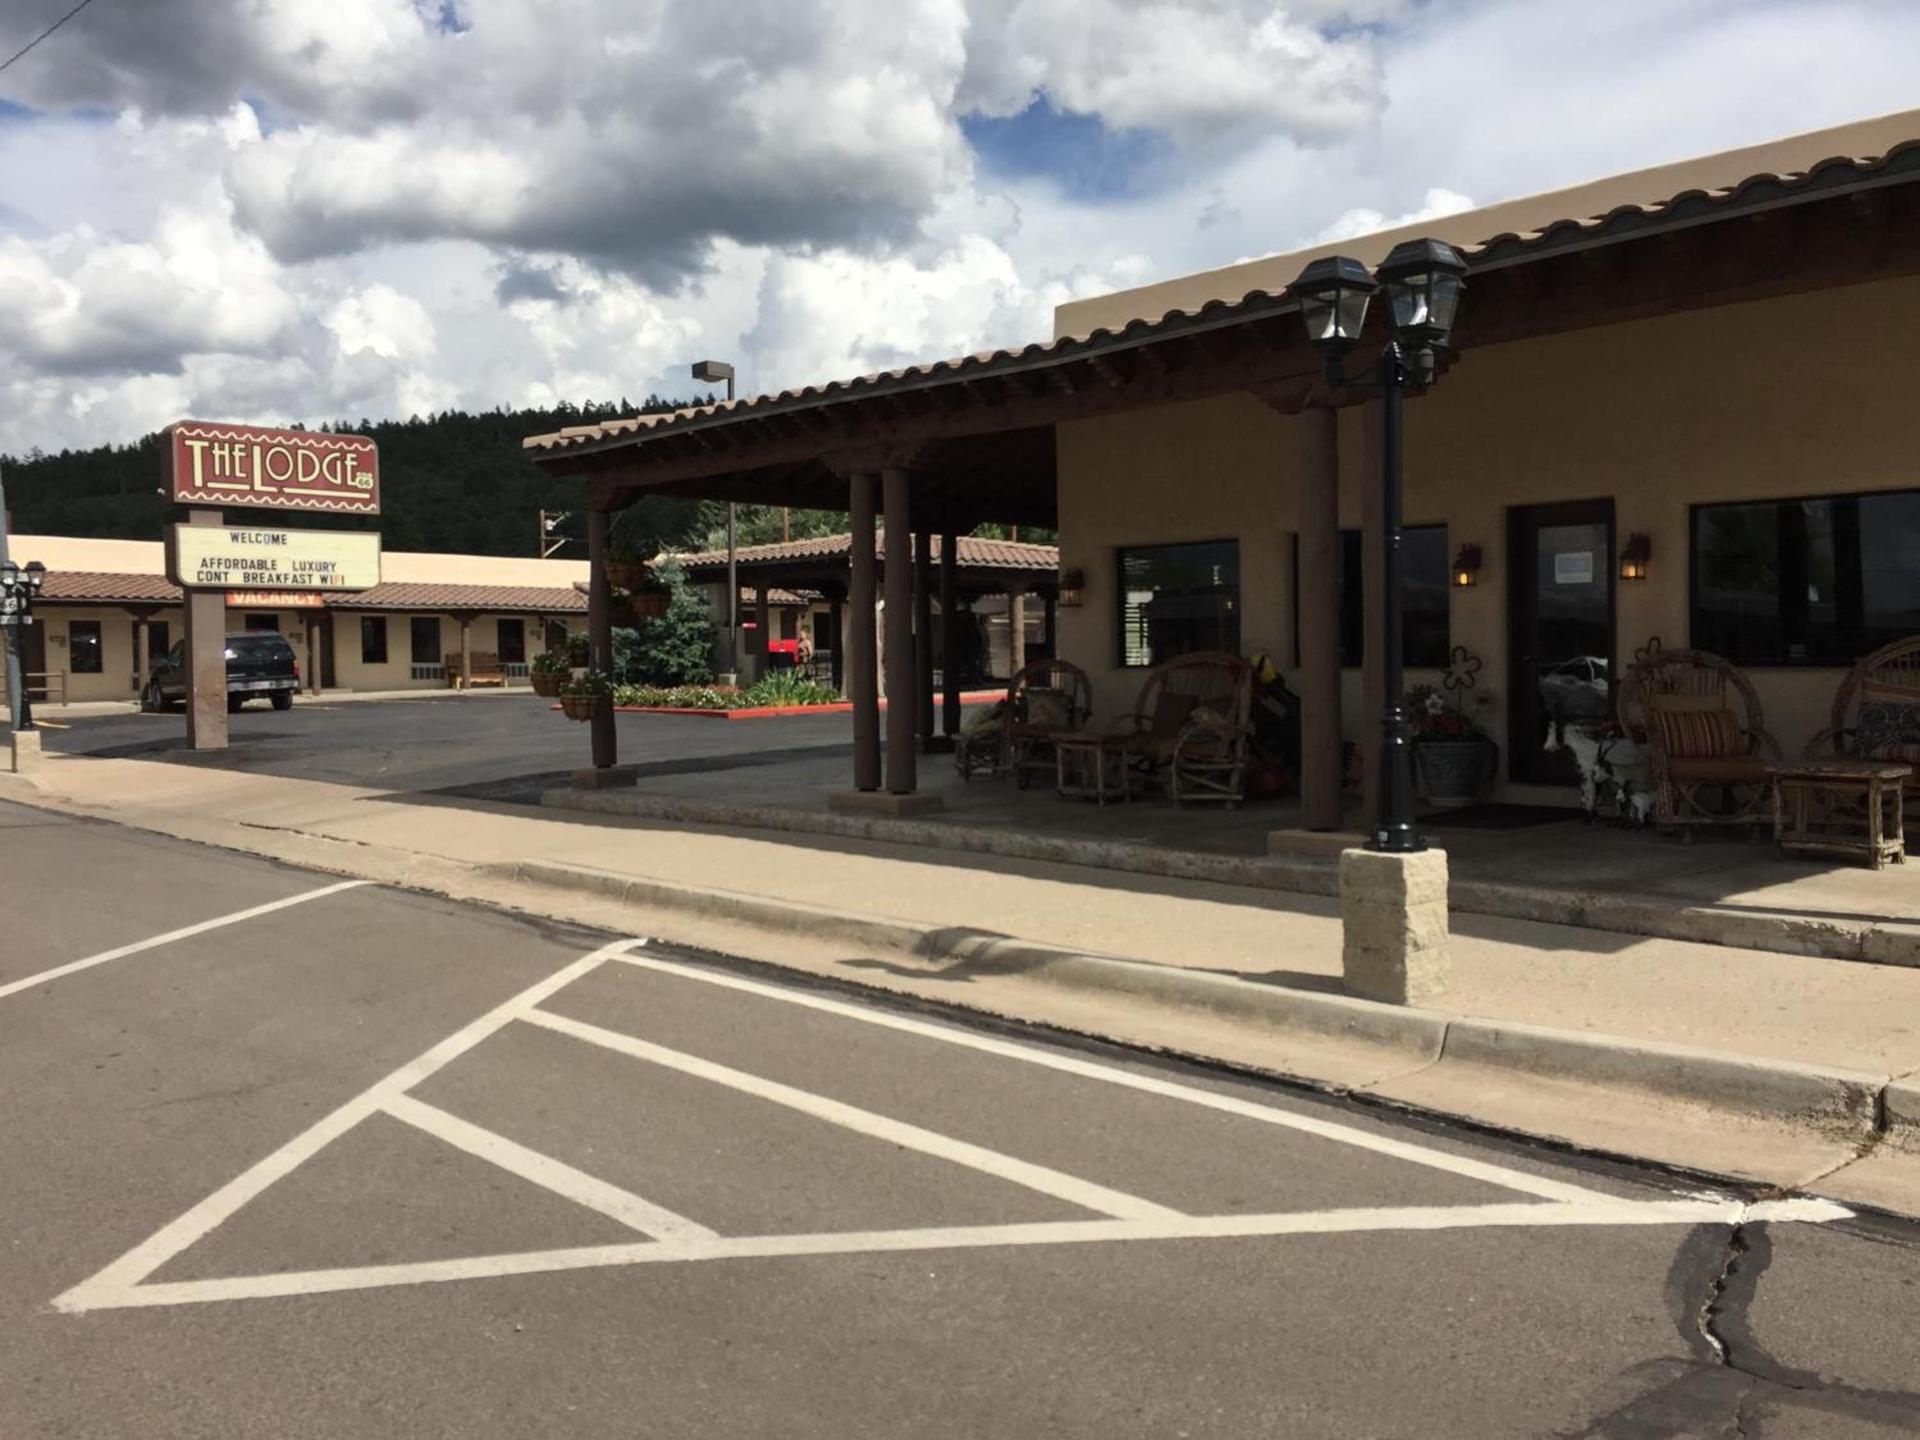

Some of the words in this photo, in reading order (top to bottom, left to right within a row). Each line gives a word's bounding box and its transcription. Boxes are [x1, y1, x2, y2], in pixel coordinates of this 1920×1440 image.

[184, 440, 247, 488] THE
[253, 445, 358, 491] LODGE
[230, 531, 288, 545] WELCOME
[200, 557, 278, 571] AFFORDABLE
[292, 560, 336, 572] LUXURY
[197, 571, 229, 582] CONT
[243, 572, 313, 584] BREAKFAST
[319, 574, 345, 585] WIFI
[234, 592, 317, 605] VACANCY
